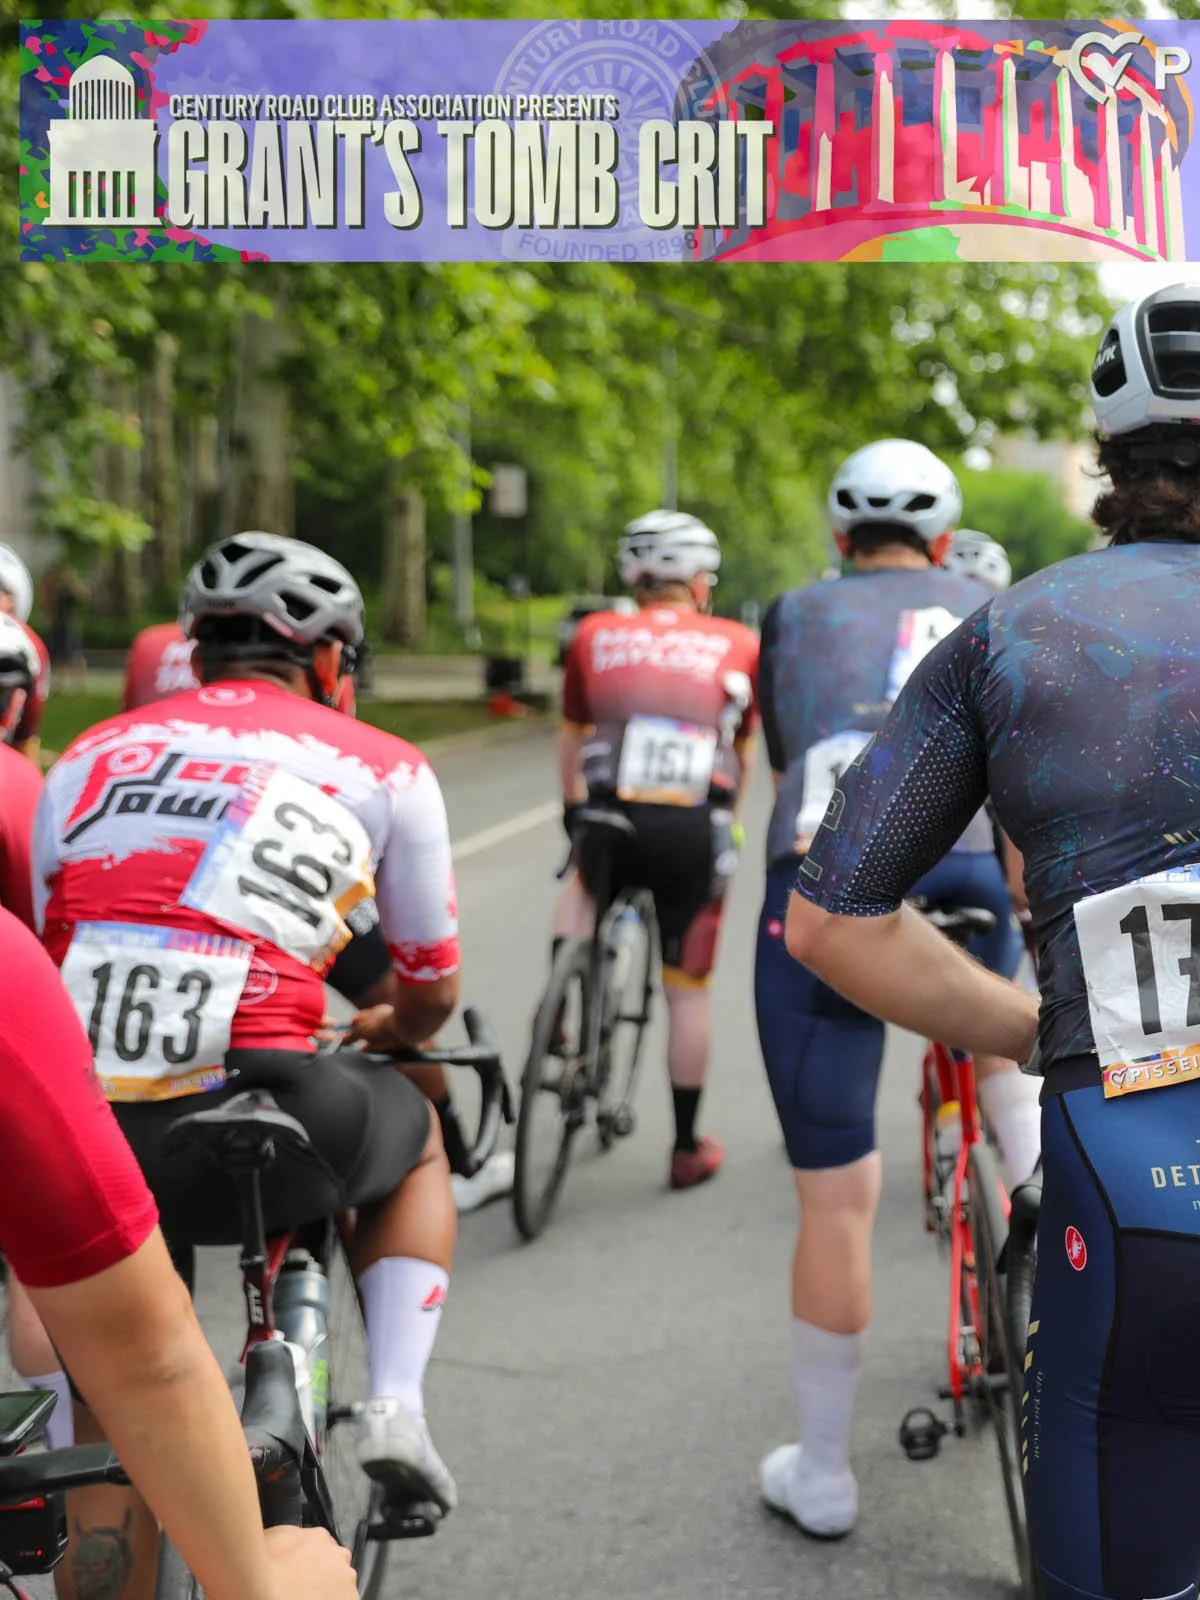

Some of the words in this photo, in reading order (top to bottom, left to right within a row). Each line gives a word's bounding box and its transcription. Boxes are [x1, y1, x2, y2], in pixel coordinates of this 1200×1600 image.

[238, 802, 354, 929] 163
[87, 961, 212, 1064] 163
[1130, 1055, 1200, 1083] PISSEI
